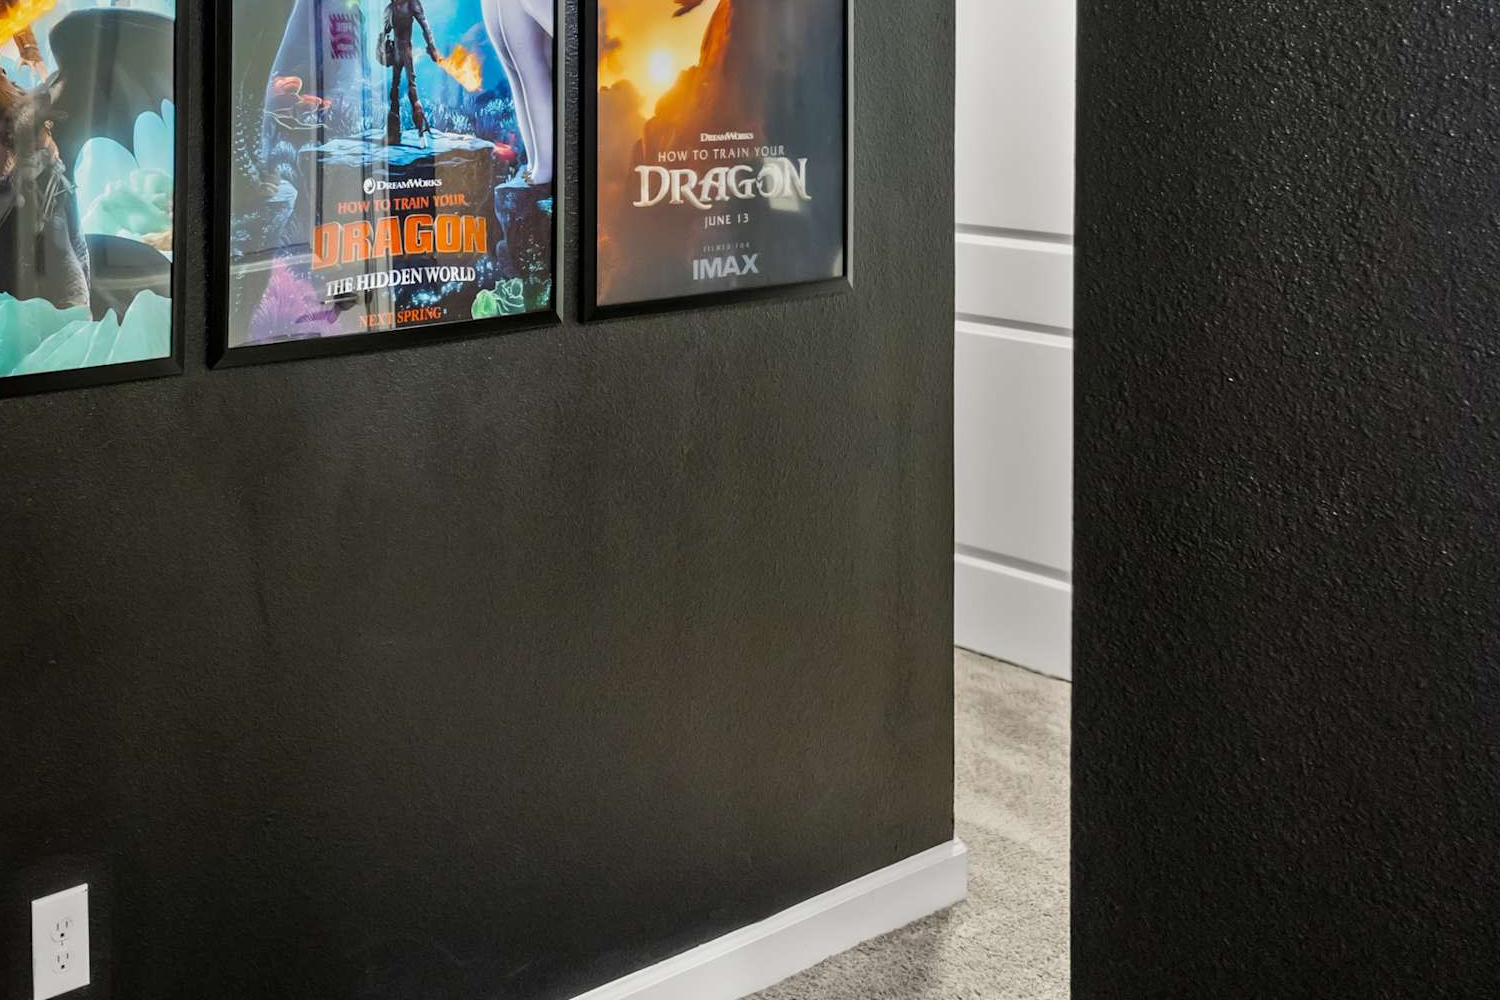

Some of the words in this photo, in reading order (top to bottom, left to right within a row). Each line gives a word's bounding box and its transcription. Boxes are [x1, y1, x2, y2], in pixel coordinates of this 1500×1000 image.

[658, 150, 688, 163] HOW
[693, 149, 708, 161] TO
[712, 147, 749, 160] TRAIN
[754, 145, 786, 157] YOUR
[632, 157, 812, 210] DRAGON
[337, 200, 371, 216] HOW
[374, 199, 391, 212] TO
[394, 196, 430, 211] TRAIN
[433, 193, 469, 208] YOUR
[704, 214, 731, 229] JUNE
[737, 213, 749, 224] 13
[311, 214, 488, 270] DRAGON
[692, 253, 759, 281] IMAX
[325, 277, 353, 297] THE
[356, 268, 423, 292] HIDDEN
[424, 266, 476, 283] WORLD
[360, 311, 393, 328] NEXT
[397, 306, 442, 324] SPRING
